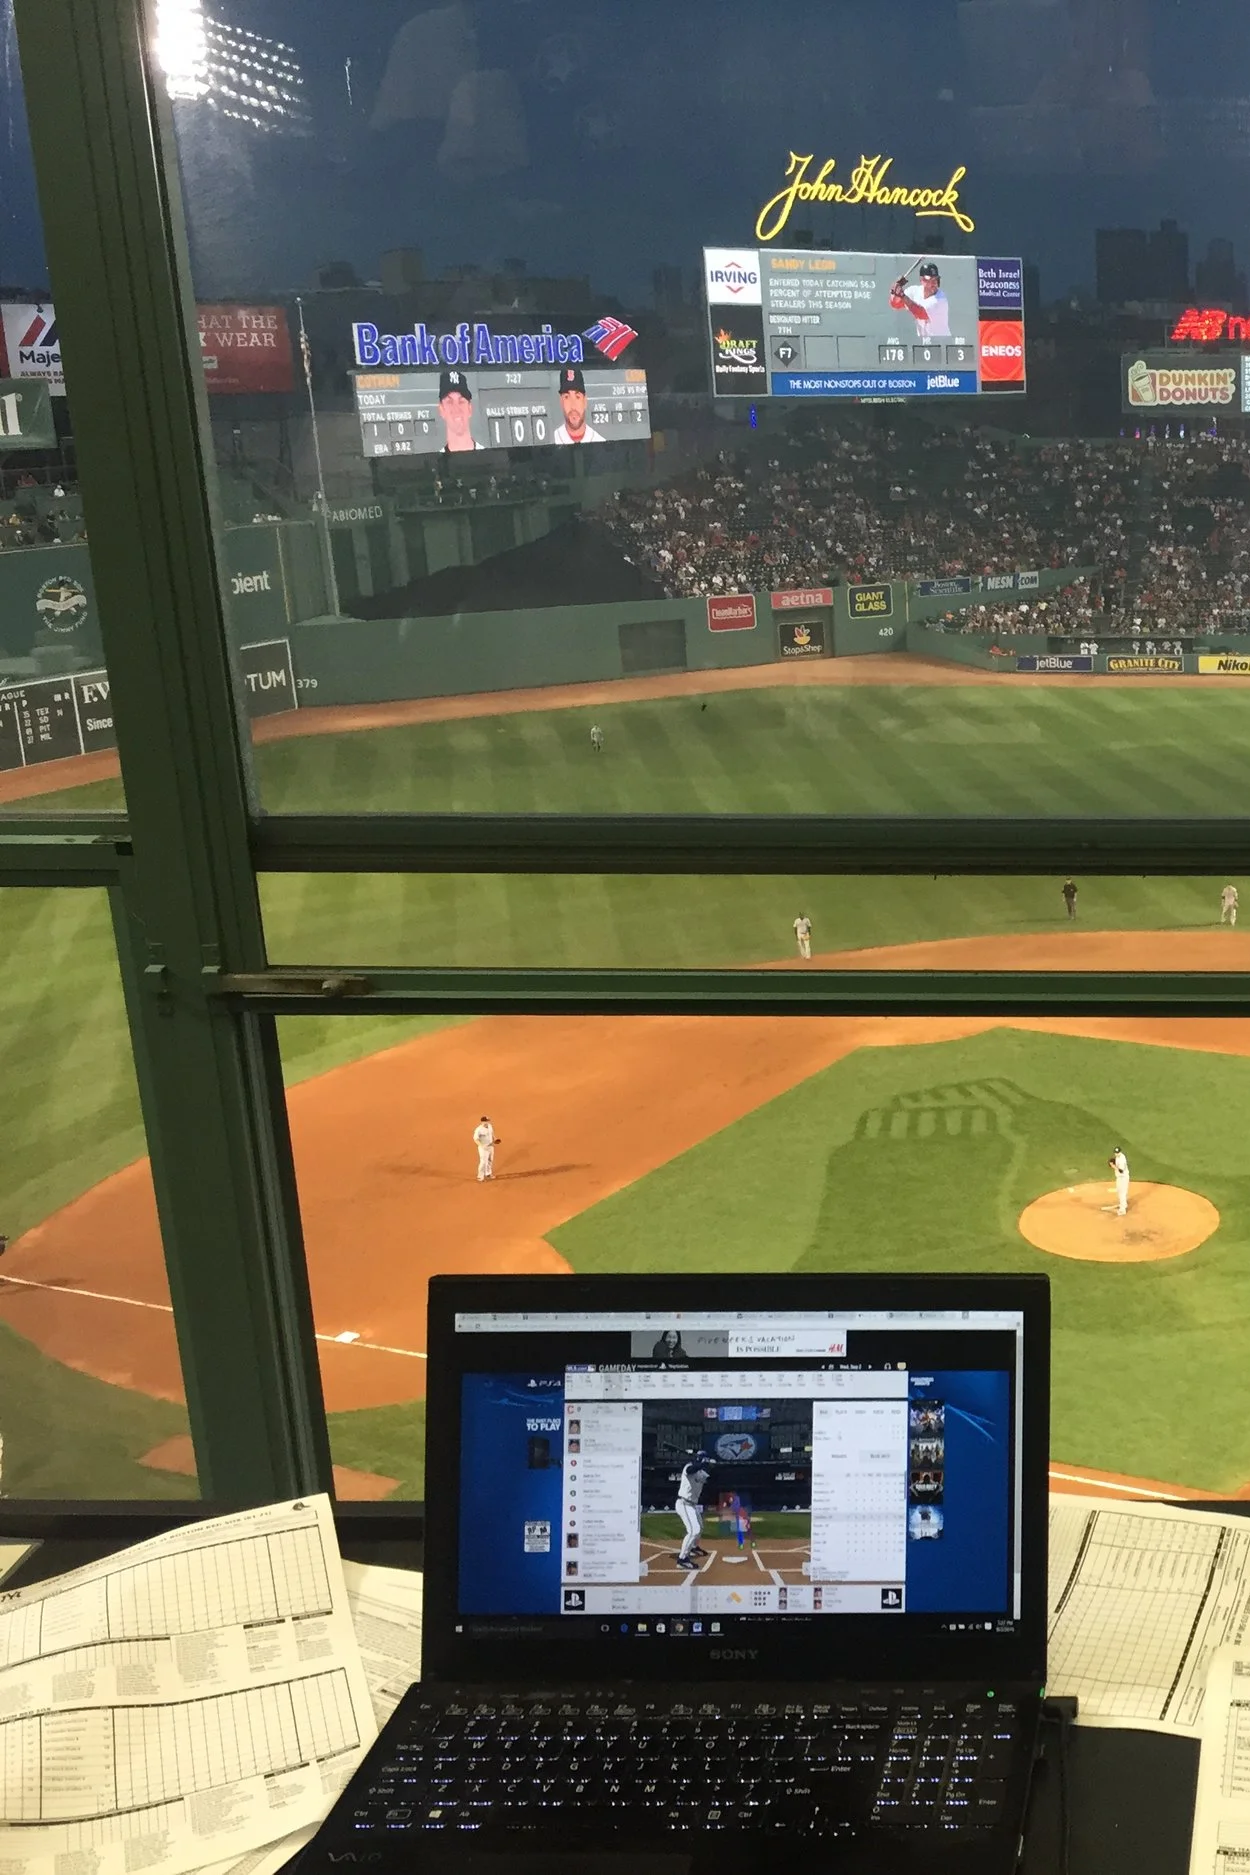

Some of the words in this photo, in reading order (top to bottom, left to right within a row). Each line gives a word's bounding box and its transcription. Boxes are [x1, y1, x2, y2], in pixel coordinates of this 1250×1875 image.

[756, 150, 845, 240] John
[844, 154, 975, 233] Hancock
[710, 270, 758, 285] IRVING
[998, 269, 1020, 279] Israel
[769, 278, 800, 287] ENTERED
[802, 279, 824, 288] TODAY
[826, 280, 858, 289] CATCHING
[979, 279, 1020, 290] Deaconess
[769, 289, 800, 298] PERCENT
[802, 290, 813, 298] OF
[815, 290, 853, 300] ATTEMPTED
[854, 291, 872, 300] BASE
[770, 300, 806, 309] STEALERS
[808, 300, 823, 309] THIS
[825, 301, 852, 310] SEASON
[238, 315, 278, 329] THE
[777, 326, 792, 335] 7TH
[215, 332, 276, 347] WEAR
[352, 322, 440, 366] Bank
[440, 323, 471, 365] of
[473, 323, 584, 365] America
[720, 338, 758, 350] DRAFT
[779, 347, 792, 359] F7
[882, 349, 904, 361] .178
[923, 350, 931, 361] 0
[957, 350, 965, 361] 3
[981, 346, 1022, 357] ENEOS
[789, 380, 802, 389] THE
[803, 380, 823, 389] MOST
[823, 380, 861, 389] NONSTOPS
[862, 380, 877, 389] OUT
[877, 380, 888, 389] OF
[888, 380, 916, 389] BOSTON
[927, 375, 960, 390] jetBlue
[1158, 372, 1233, 387] DUNKIN'
[357, 394, 386, 405] TODAY
[1159, 387, 1230, 401] DONUTS
[417, 410, 430, 419] PCT
[486, 406, 506, 416] BALLS
[506, 405, 530, 415] STRIKES
[531, 404, 546, 414] OUTS
[362, 412, 385, 421] TOTAL
[386, 411, 412, 420] STRIKES
[617, 412, 623, 422] 0
[636, 412, 642, 422] 2
[397, 424, 404, 435] 0
[422, 422, 429, 433] 0
[494, 421, 501, 443] 1
[514, 420, 525, 442] 0
[535, 419, 546, 441] 0
[332, 505, 383, 522] ABIOMED
[987, 576, 1014, 590] NESN
[781, 592, 824, 606] aetna
[855, 591, 885, 602] GIANT
[855, 601, 887, 612] GLASS
[878, 628, 894, 637] 420
[1036, 657, 1073, 671] jetBlue
[1109, 658, 1156, 669] GRANITE
[1158, 657, 1181, 670] CITY
[245, 668, 287, 692] TUM
[296, 678, 318, 689] 379
[86, 716, 113, 732] Since
[599, 1364, 637, 1373] GAMEDAY
[526, 1423, 539, 1431] TO
[540, 1423, 560, 1431] PLAY
[709, 1648, 759, 1661] SONY
